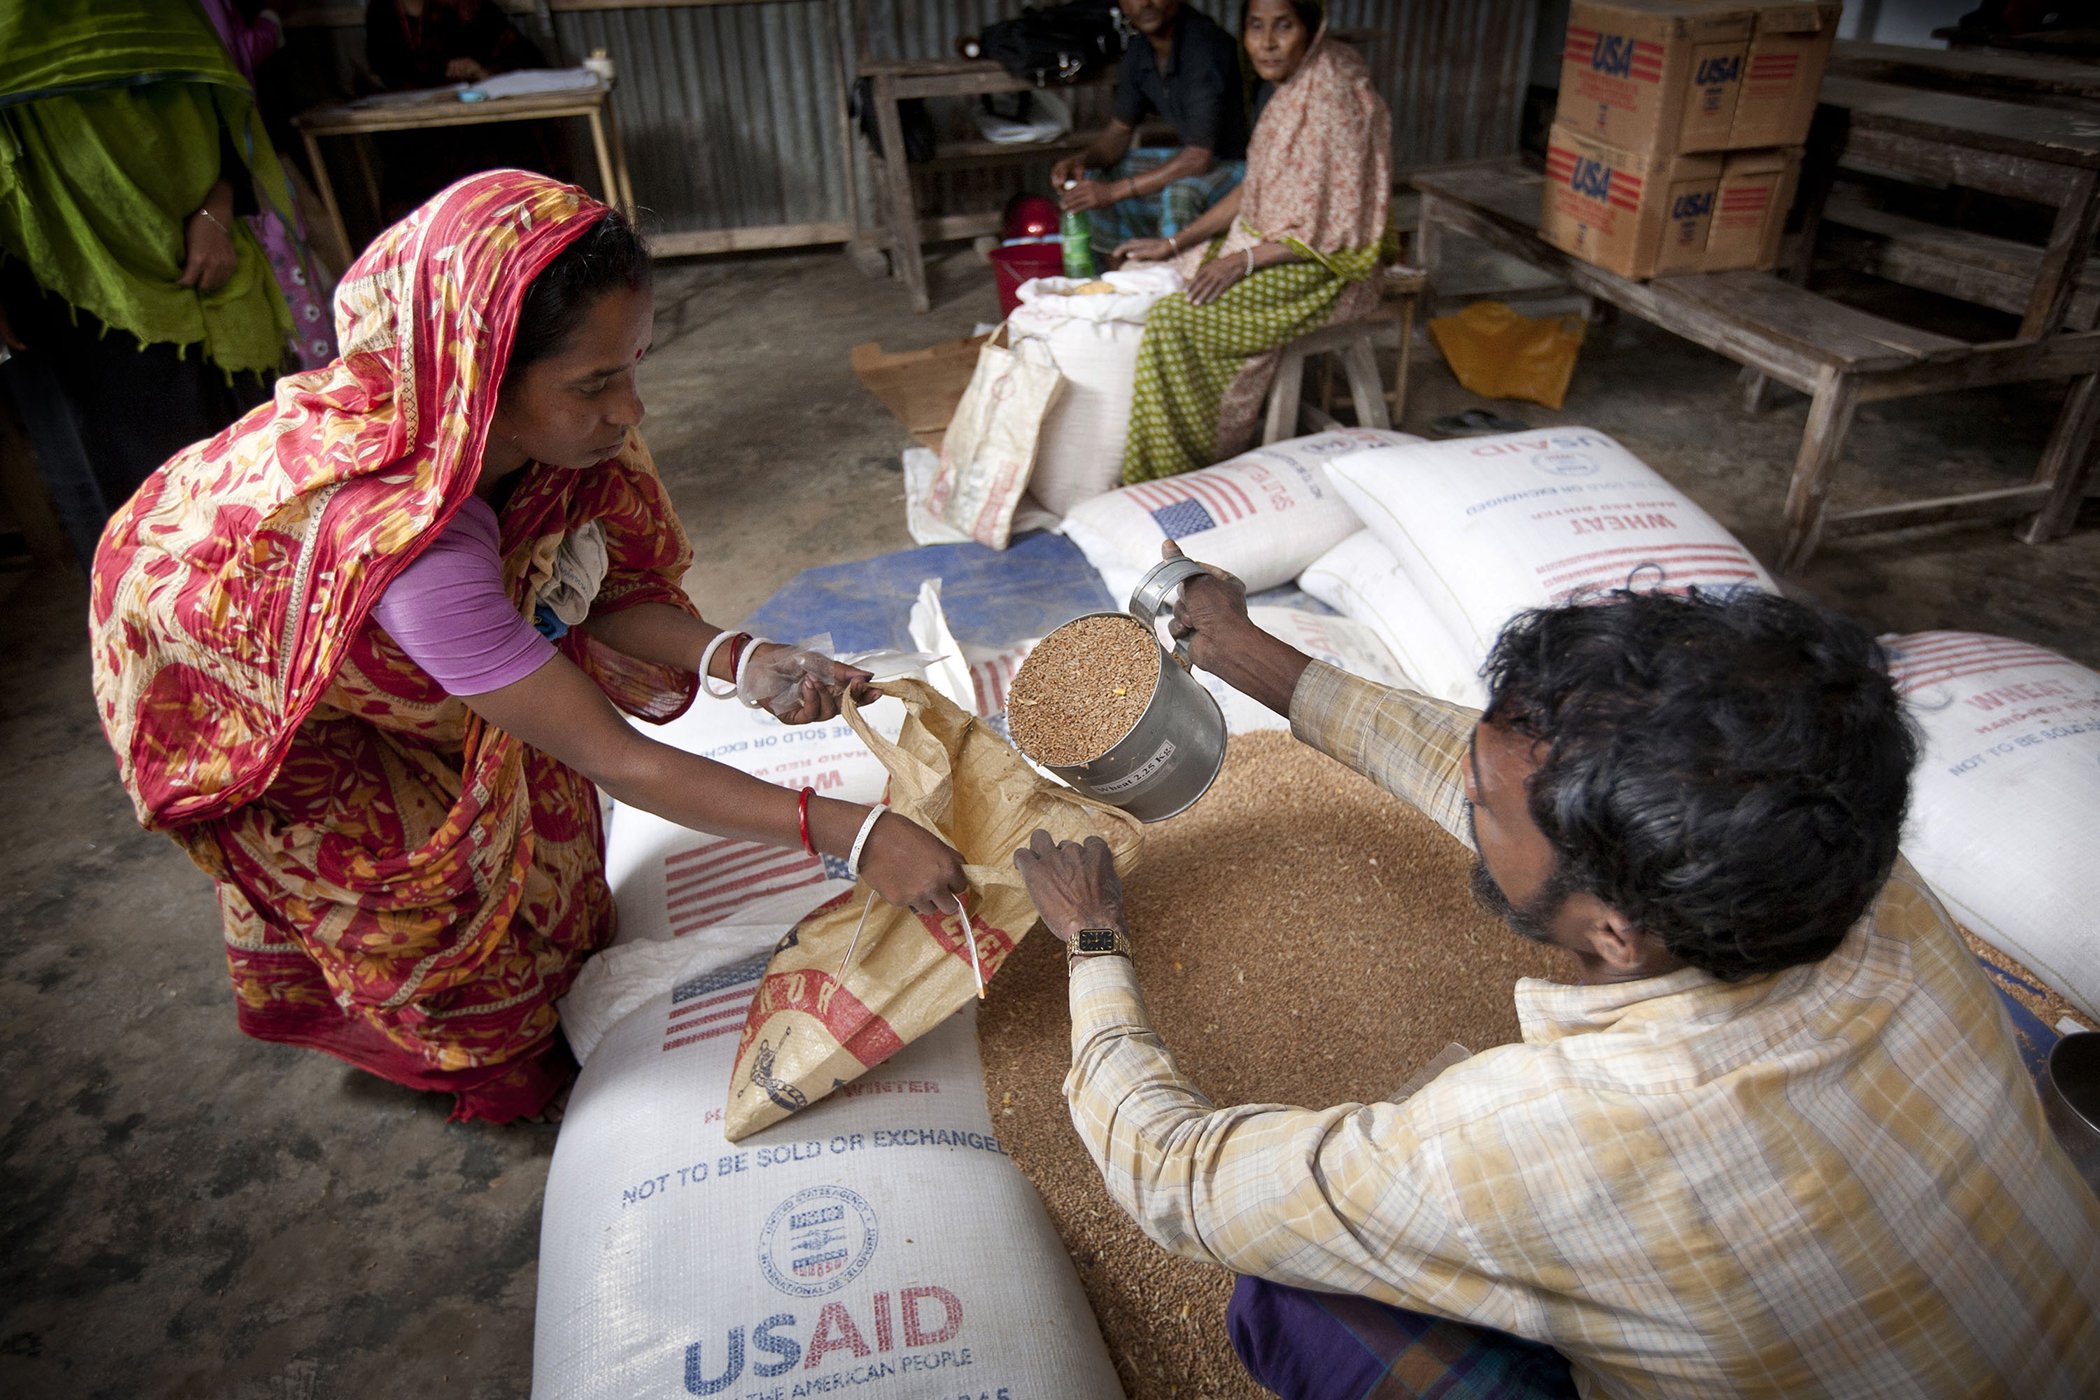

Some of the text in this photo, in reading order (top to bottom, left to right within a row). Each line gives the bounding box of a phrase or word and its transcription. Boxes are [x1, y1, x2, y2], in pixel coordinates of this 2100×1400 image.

[1591, 33, 1636, 79] USA
[1696, 56, 1740, 85] USA
[1571, 156, 1614, 204] USA
[1672, 192, 1714, 221] USA
[1470, 436, 1613, 456] USAID
[1465, 487, 1557, 517] EXCHANGED
[1531, 504, 1597, 520] WINTER
[1570, 512, 1678, 535] WHEAT
[1964, 679, 2074, 711] WHEAT
[782, 728, 826, 744] SOLD
[1975, 713, 2027, 734] HARD
[753, 735, 778, 749] OR
[1949, 753, 1987, 777] NOT
[1986, 742, 2015, 757] TO
[2014, 733, 2043, 747] BE
[775, 758, 812, 772] RED
[817, 750, 868, 765] HARD
[1097, 779, 1132, 793] Wheat
[1134, 763, 1155, 781] 2.25
[843, 1079, 940, 1098] WINTER
[622, 1174, 670, 1208] NOT
[677, 1162, 708, 1187] TO
[718, 1152, 749, 1177] BE
[756, 1140, 821, 1168] SOLD
[830, 1133, 865, 1154] OR
[831, 1188, 869, 1212] AGENCY
[684, 1285, 964, 1396] USAID
[791, 1361, 895, 1398] AMERICAN
[902, 1348, 973, 1372] PEOPLE
